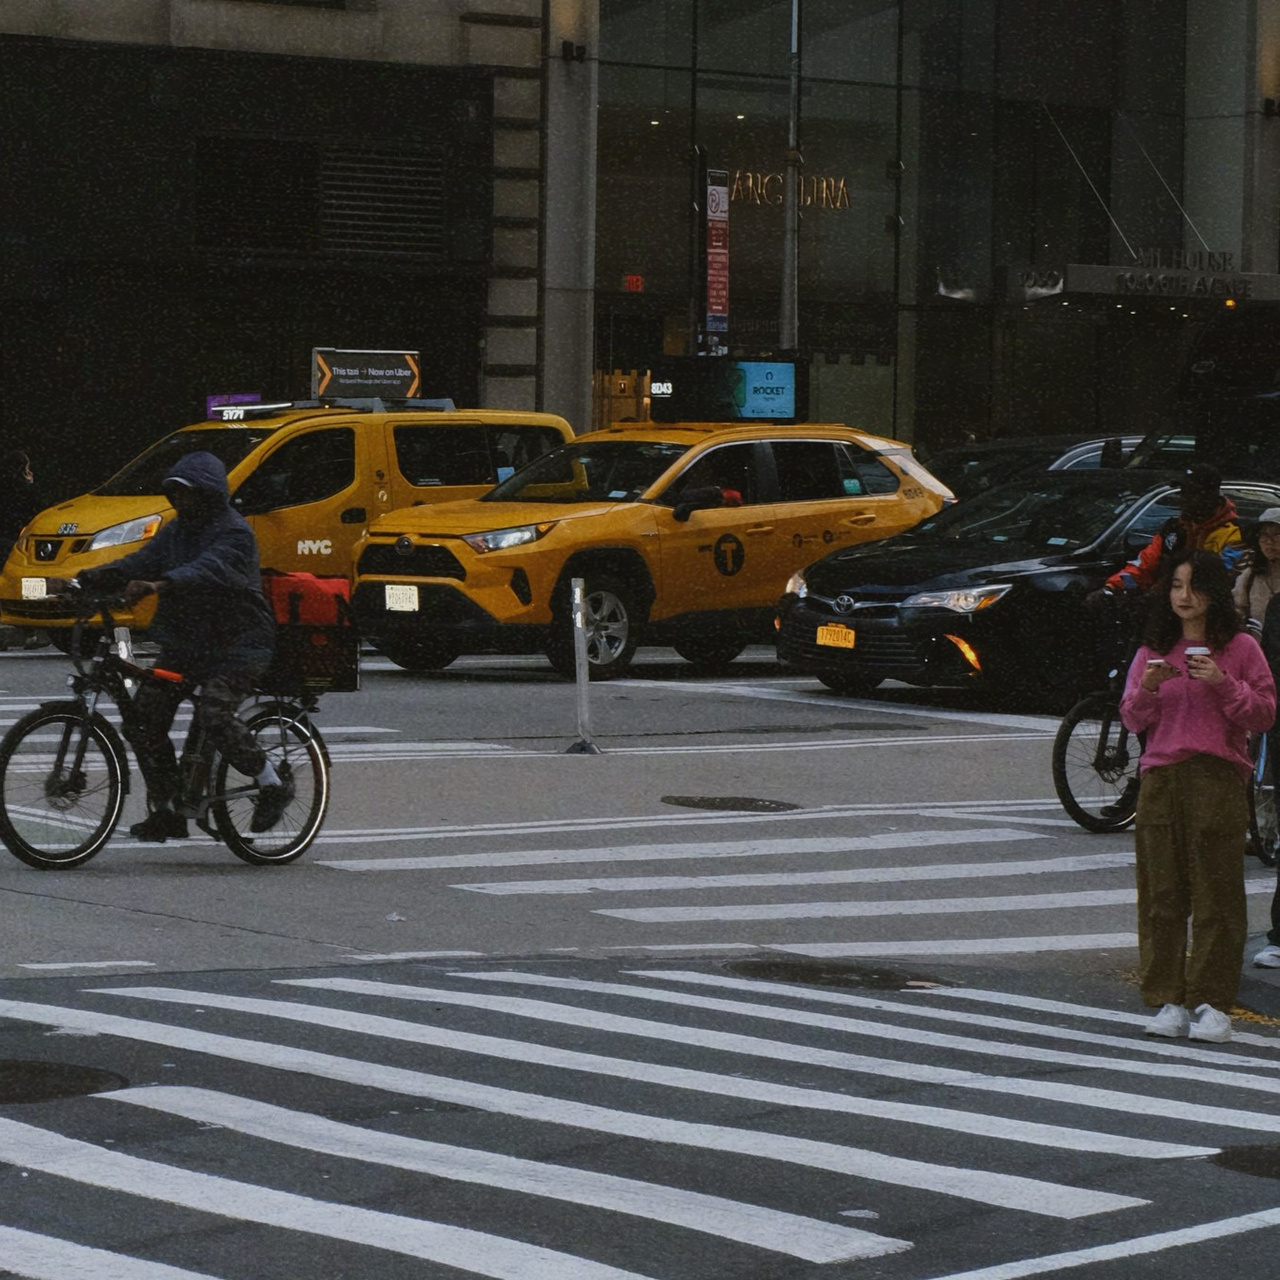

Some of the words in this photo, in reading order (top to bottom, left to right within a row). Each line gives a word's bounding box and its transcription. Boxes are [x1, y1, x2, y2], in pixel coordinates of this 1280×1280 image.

[731, 170, 850, 209] ANGLINA
[332, 366, 347, 376] This
[368, 367, 385, 376] Now
[395, 368, 412, 377] Uber
[651, 382, 673, 395] 8D43
[753, 386, 785, 396] ROCKET
[297, 539, 332, 555] NYC
